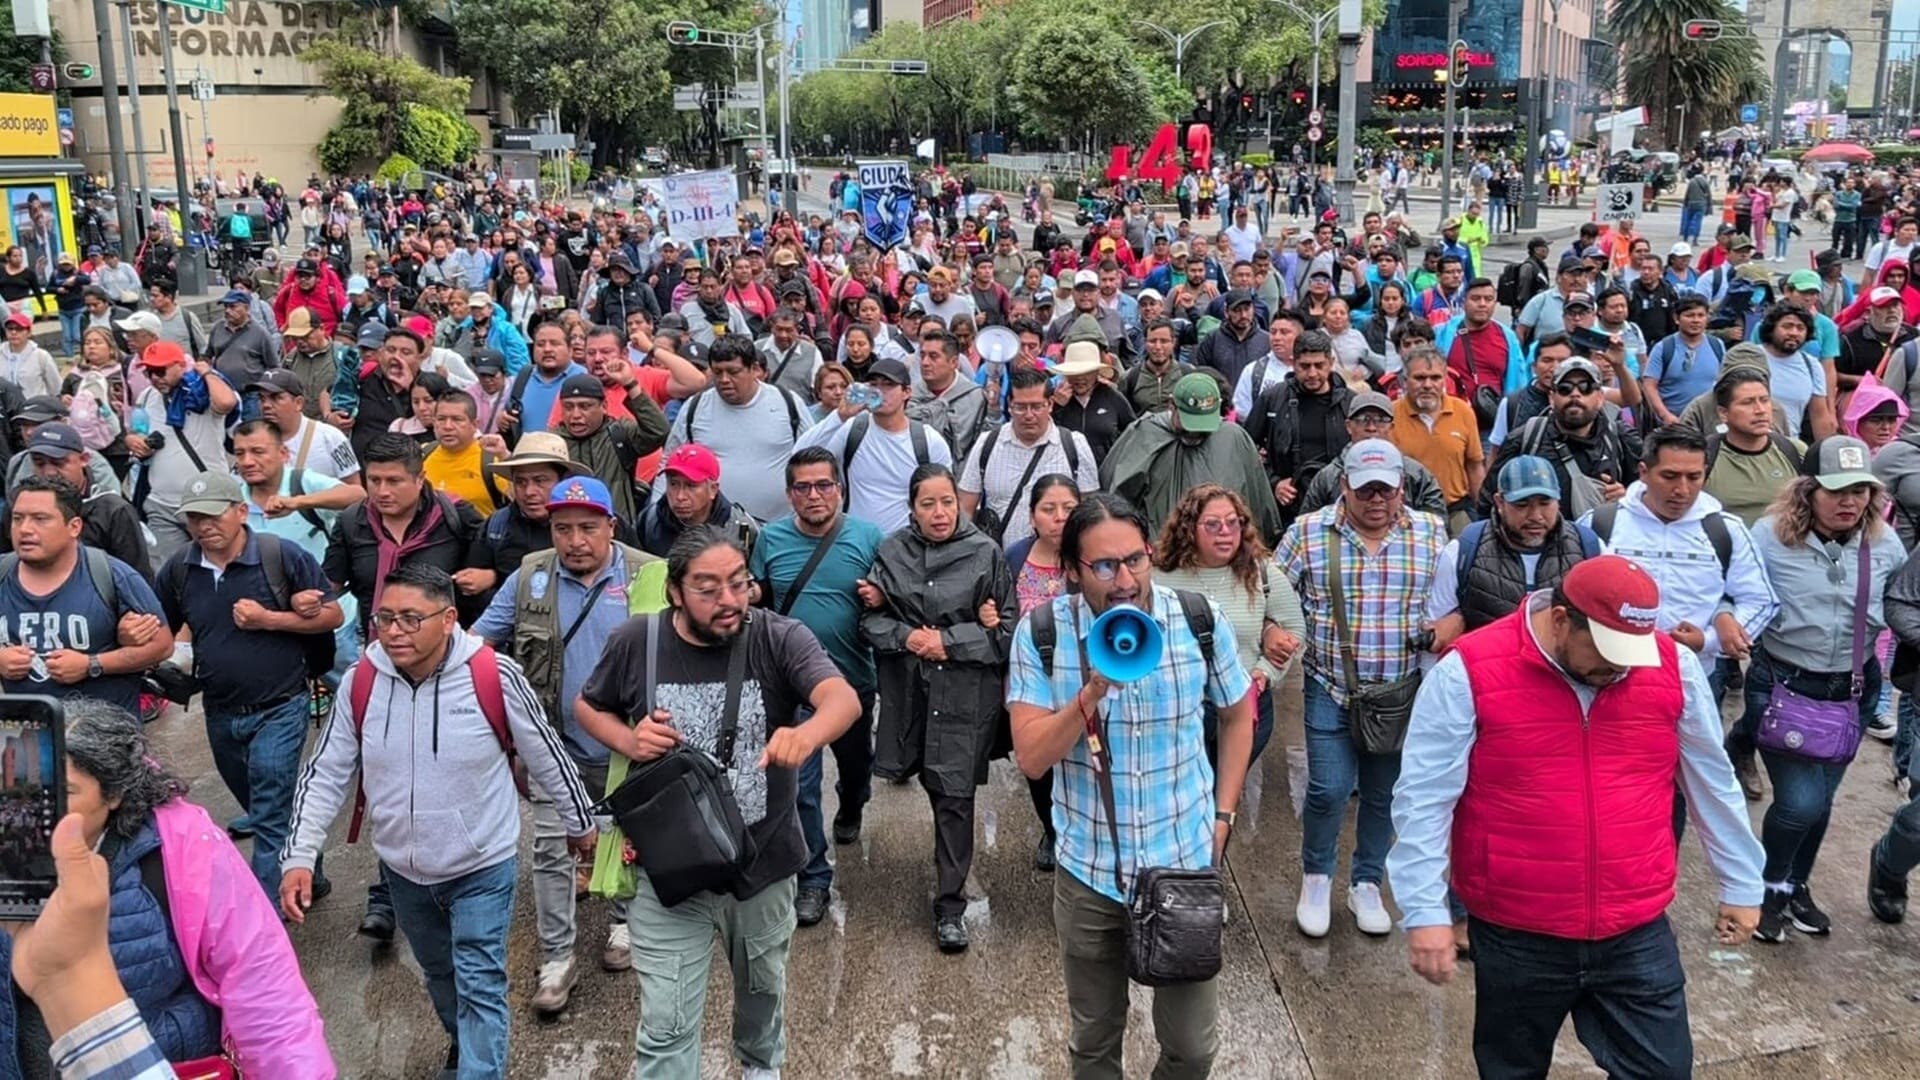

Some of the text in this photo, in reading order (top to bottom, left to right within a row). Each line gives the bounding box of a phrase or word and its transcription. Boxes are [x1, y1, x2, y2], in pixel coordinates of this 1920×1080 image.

[130, 0, 268, 26] ESQUINA
[0, 113, 48, 136] ado pago
